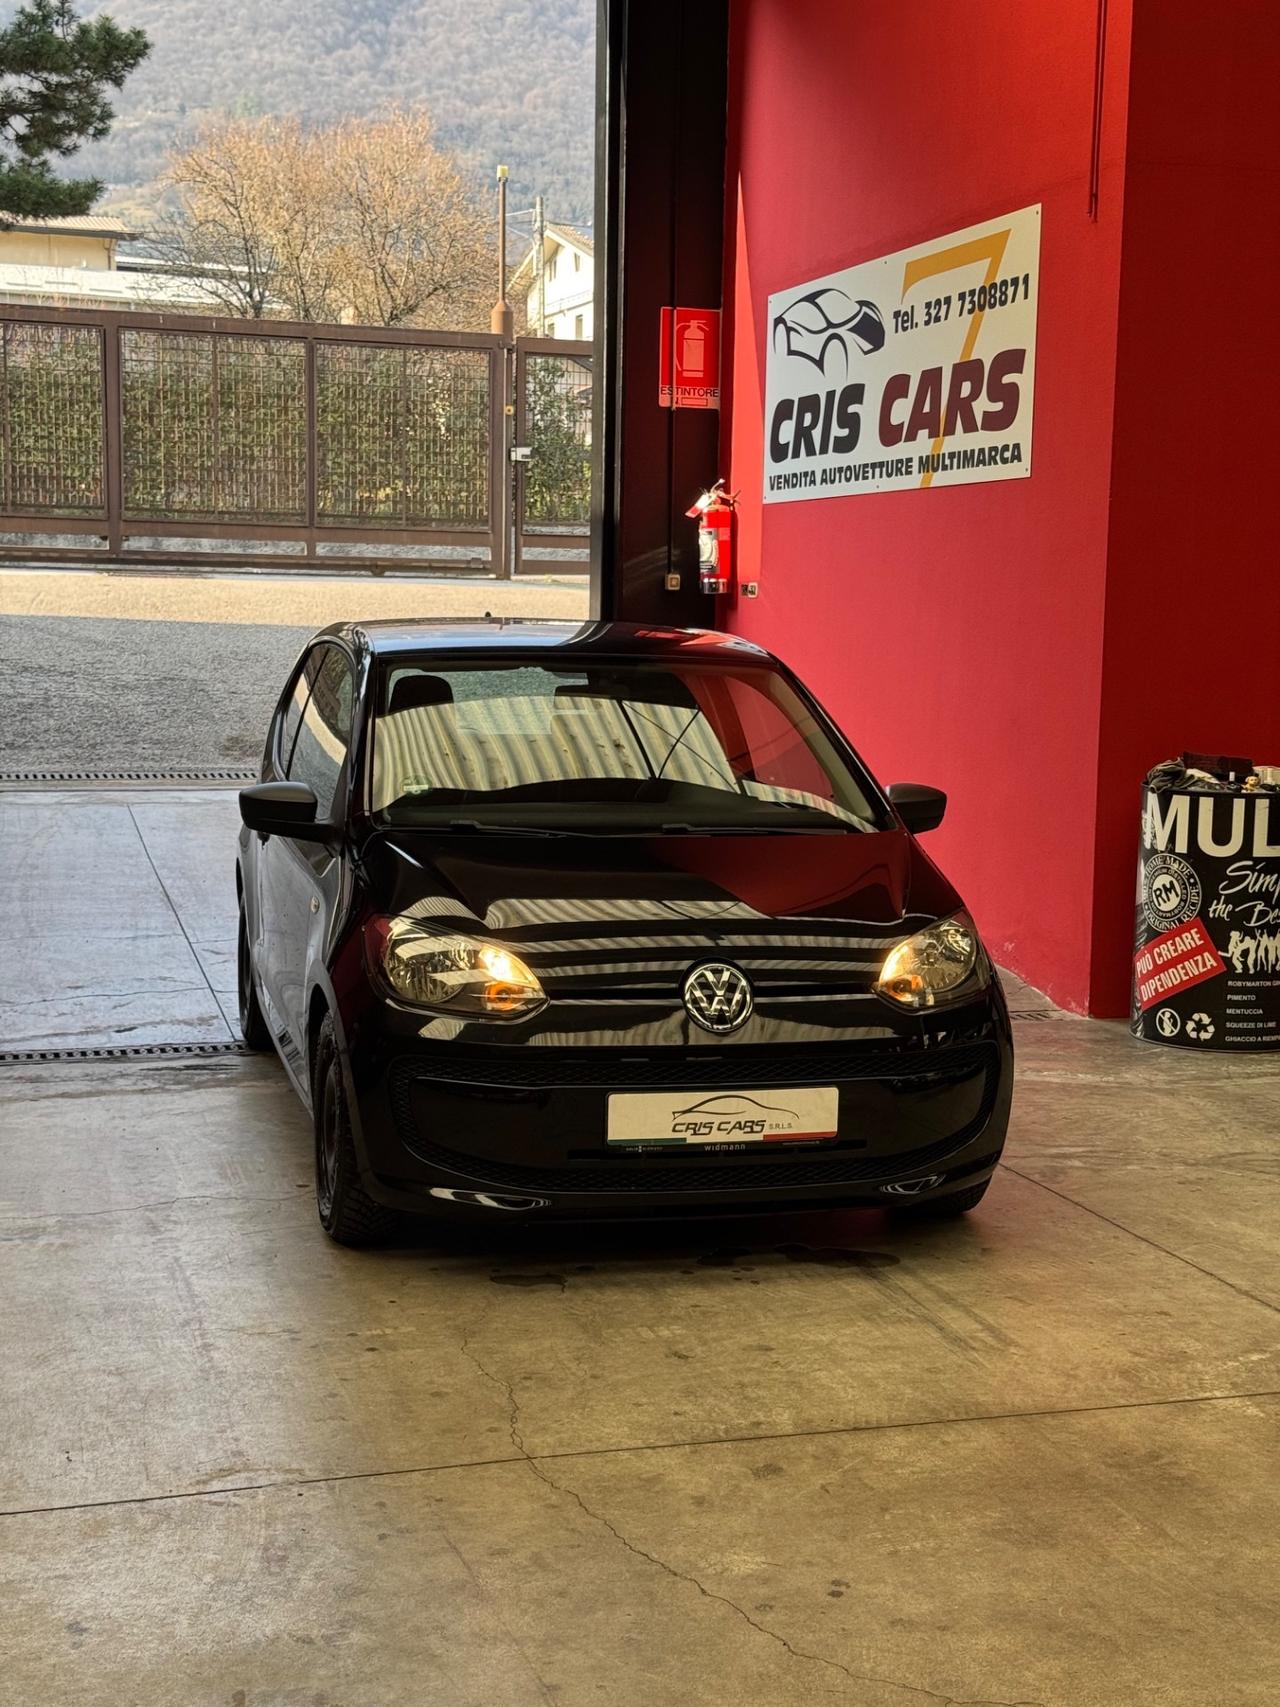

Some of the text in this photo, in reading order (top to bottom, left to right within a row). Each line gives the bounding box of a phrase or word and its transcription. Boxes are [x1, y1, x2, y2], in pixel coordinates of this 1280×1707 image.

[893, 273, 1030, 334] Tel. 327 7308871
[660, 386, 719, 397] ESTINTORE
[769, 348, 1027, 464] CRIS CARS
[769, 442, 1022, 491] VENDITA AUTOVETTURE MULTIMARCA
[1153, 880, 1180, 907] RM
[1180, 885, 1200, 923] RECIPE
[1208, 895, 1232, 921] the
[1153, 928, 1205, 965] CREARE
[1139, 952, 1218, 1002] DIPENDENZA
[671, 1120, 715, 1136] CRIS
[717, 1119, 767, 1135] CARS
[704, 1143, 746, 1152] widmann
